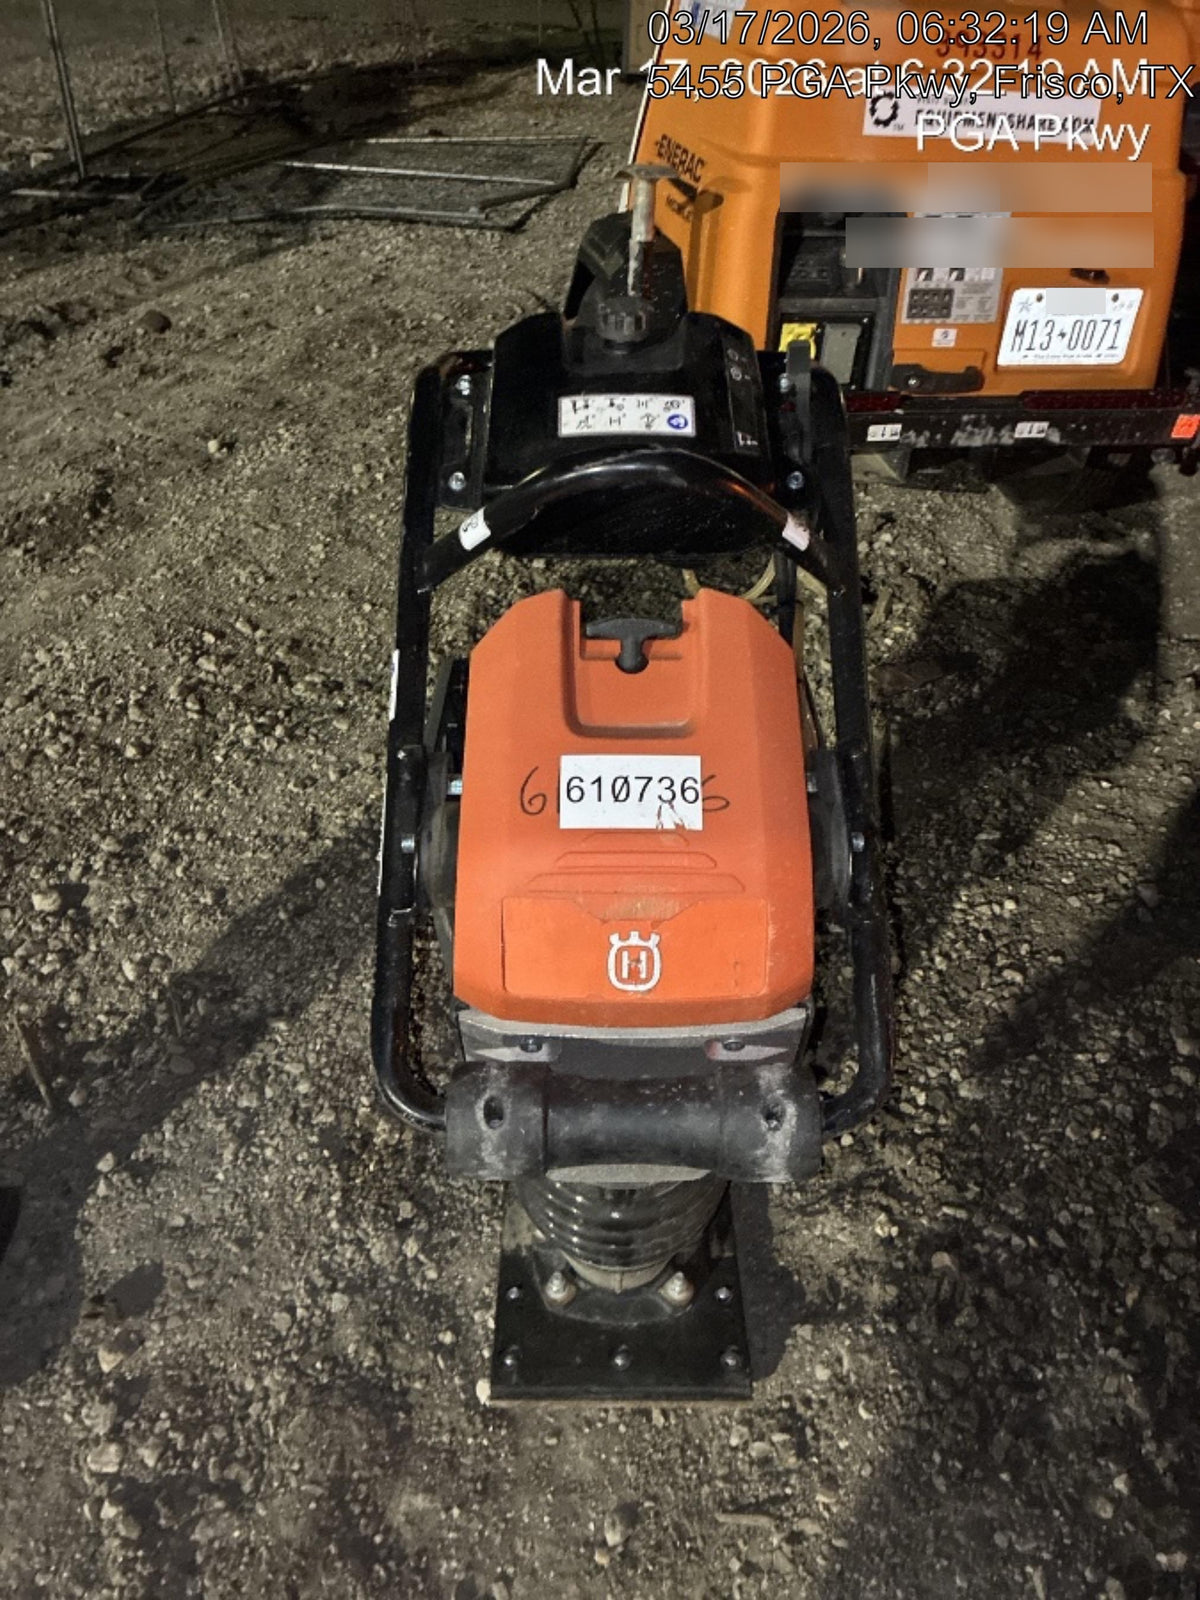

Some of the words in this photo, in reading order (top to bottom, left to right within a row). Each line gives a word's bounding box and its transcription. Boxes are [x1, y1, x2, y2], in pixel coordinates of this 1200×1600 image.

[914, 109, 1095, 134] EQUIPMENSHARECOM
[655, 133, 706, 183] ENERAC
[566, 775, 700, 804] 610736
